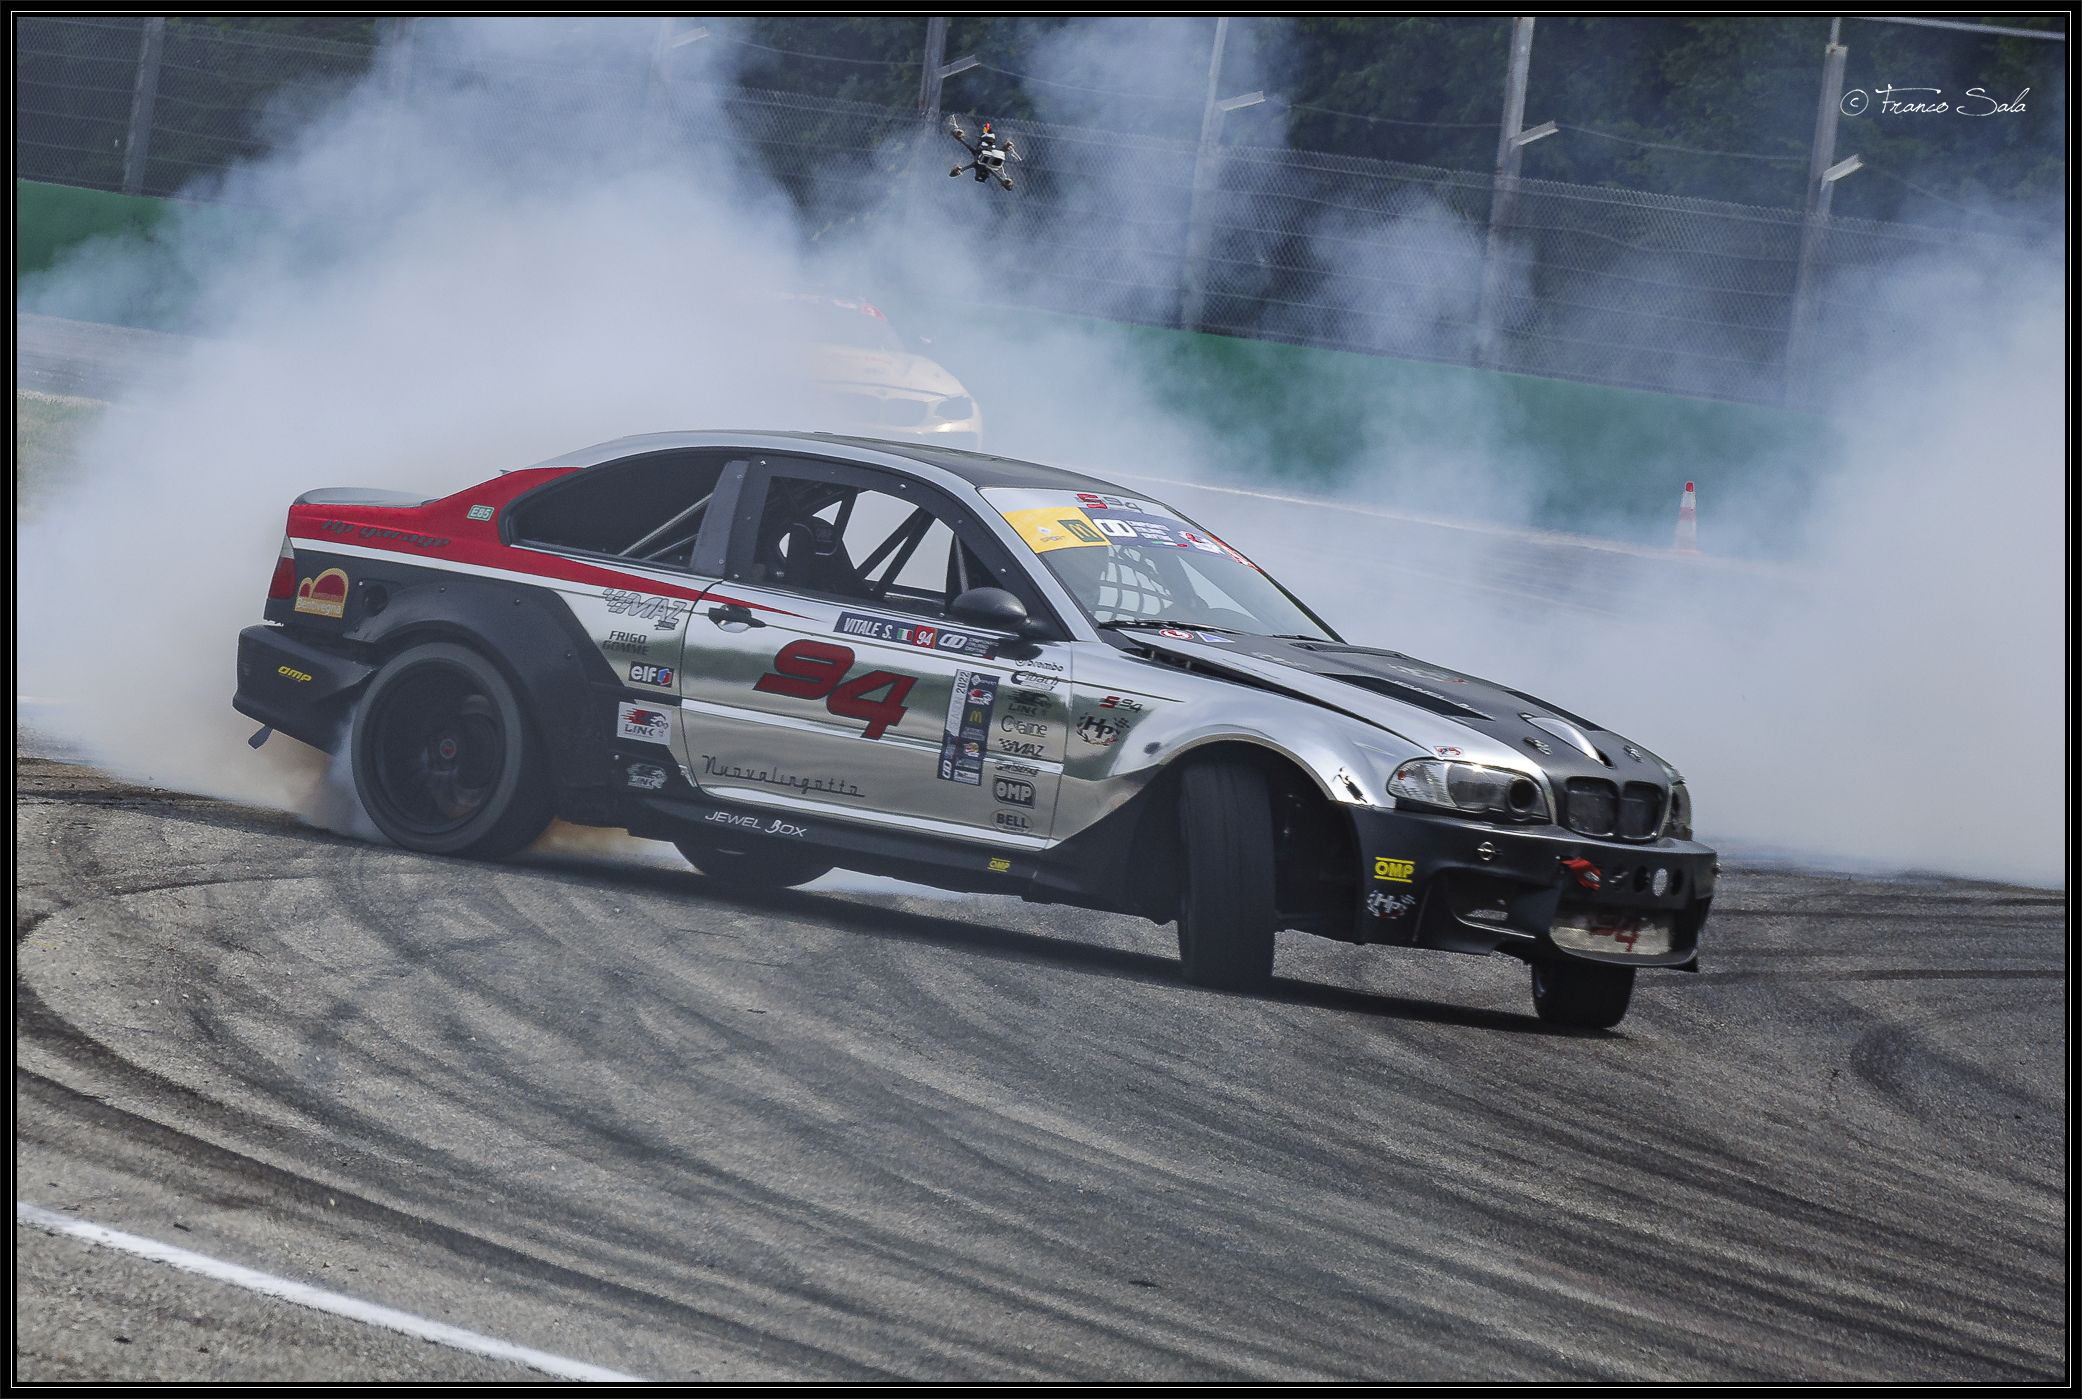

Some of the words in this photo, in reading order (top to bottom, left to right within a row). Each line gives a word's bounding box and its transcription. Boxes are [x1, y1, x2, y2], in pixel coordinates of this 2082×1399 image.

[471, 507, 490, 518] E85
[609, 631, 647, 643] FRIGO
[843, 617, 882, 637] VITALE
[882, 625, 894, 639] S.
[916, 631, 933, 645] 94
[1028, 659, 1064, 671] brembo
[631, 666, 657, 682] elf
[752, 639, 919, 740] 94
[956, 671, 972, 694] 2022
[625, 724, 654, 736] LINK
[996, 781, 1032, 801] OMP
[705, 811, 761, 829] JEWEL
[765, 819, 807, 837] BOX
[996, 812, 1029, 828] BELL
[1375, 861, 1414, 878] OMP
